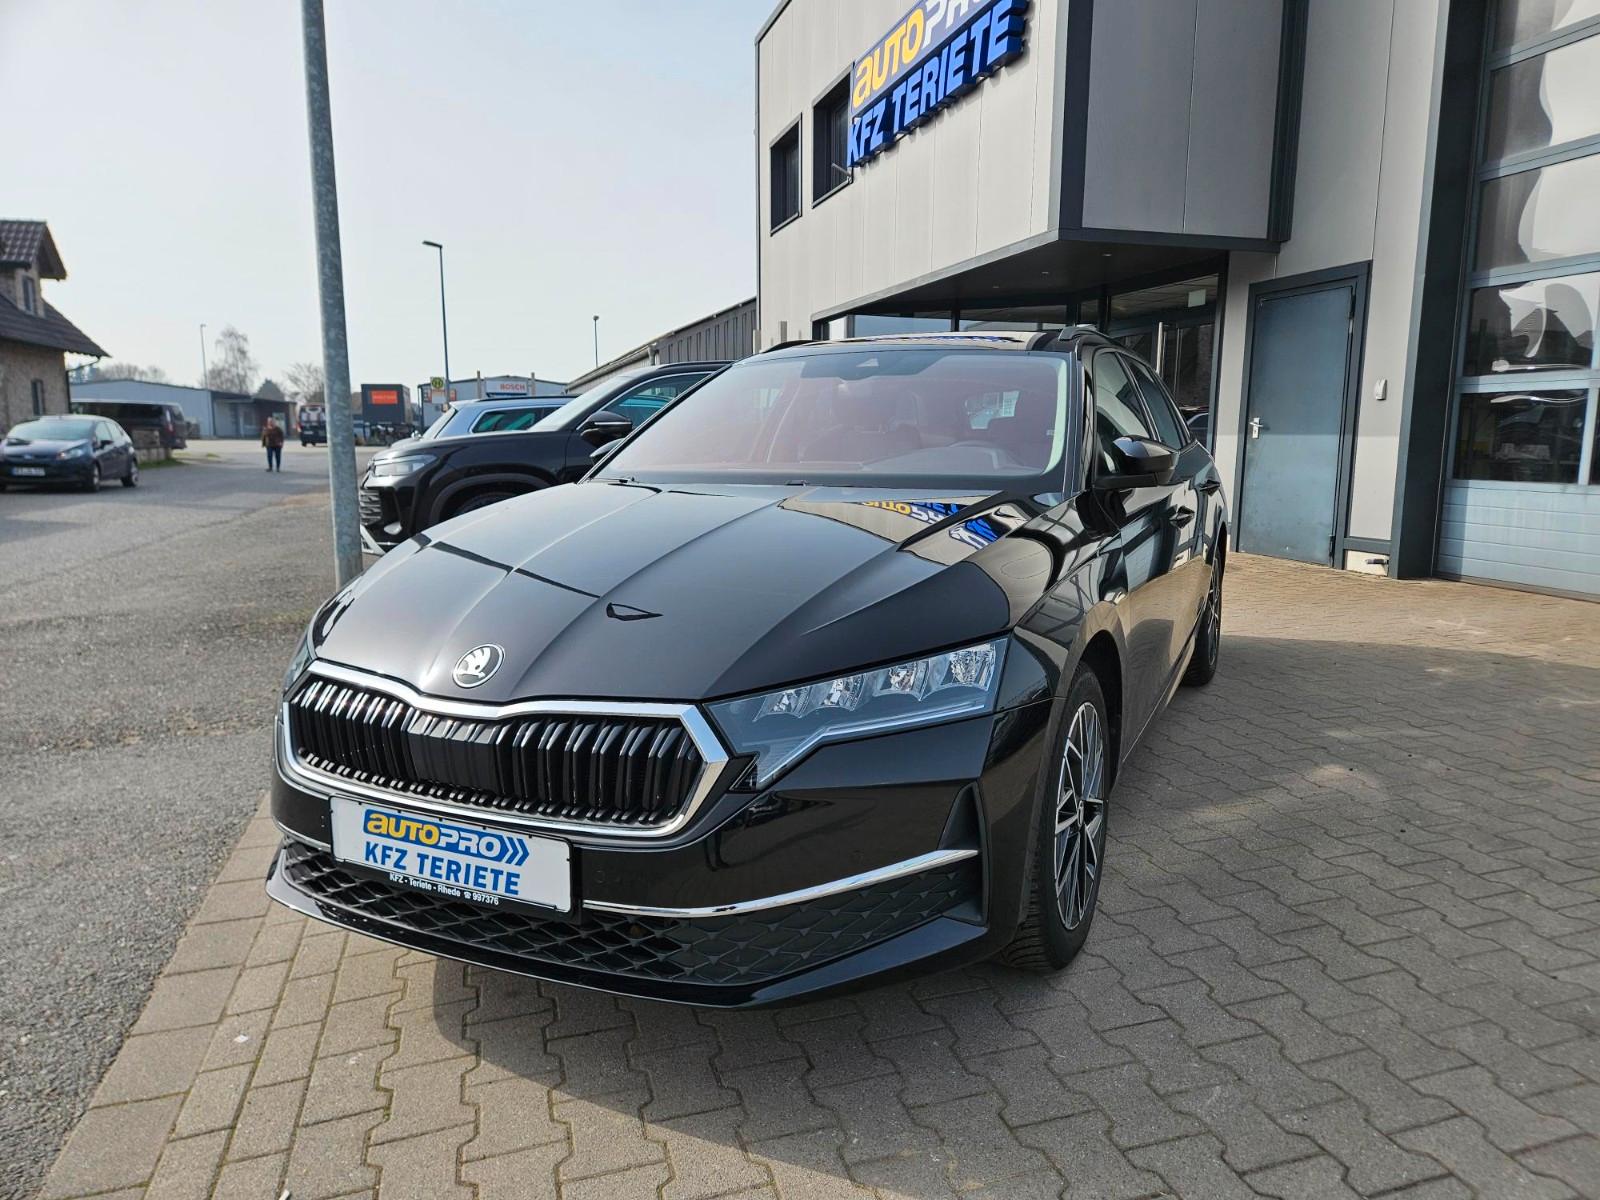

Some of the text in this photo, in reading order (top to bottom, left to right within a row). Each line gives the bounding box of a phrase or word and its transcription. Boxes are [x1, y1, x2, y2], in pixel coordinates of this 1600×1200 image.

[847, 0, 1013, 168] KFZ TERIETE
[500, 383, 526, 391] BOSCH
[364, 841, 521, 896] KFZ TERIETE
[389, 872, 499, 906] KFZ Teriete Rhede 997376
